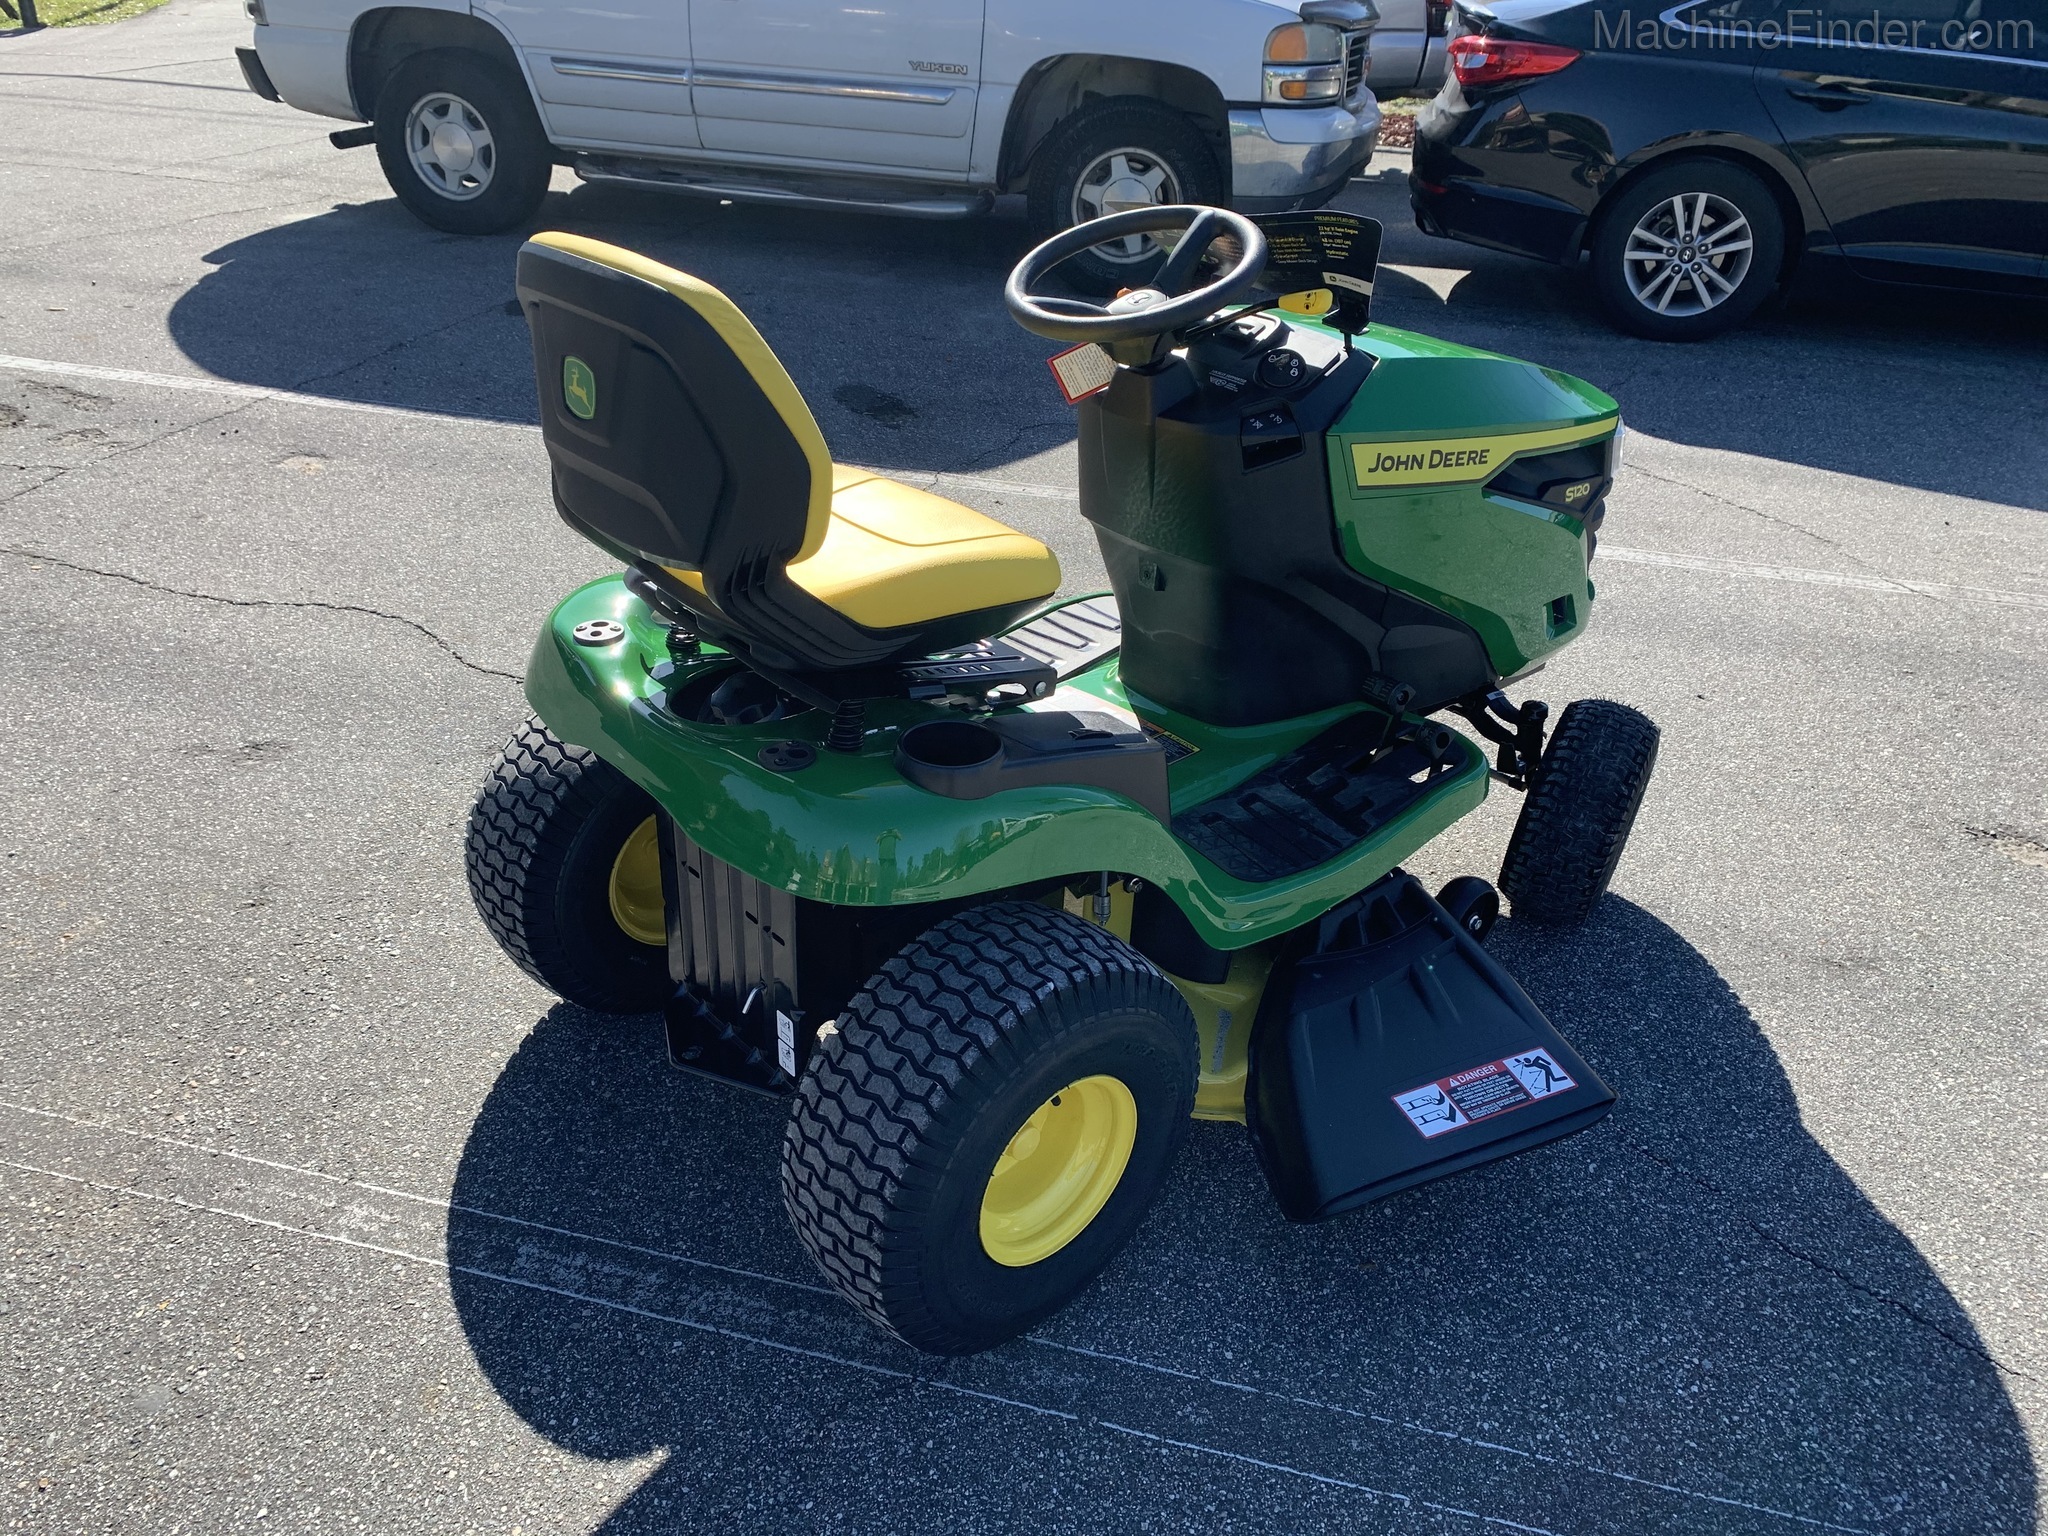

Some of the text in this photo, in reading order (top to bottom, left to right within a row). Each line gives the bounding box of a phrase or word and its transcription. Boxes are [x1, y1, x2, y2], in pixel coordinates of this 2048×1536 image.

[908, 60, 968, 75] YUKON
[1367, 449, 1490, 473] JOHN DEERE
[1565, 483, 1590, 503] S120
[1456, 1064, 1498, 1083] DANGER
[1463, 1083, 1509, 1101] THROWN OBJECTS
